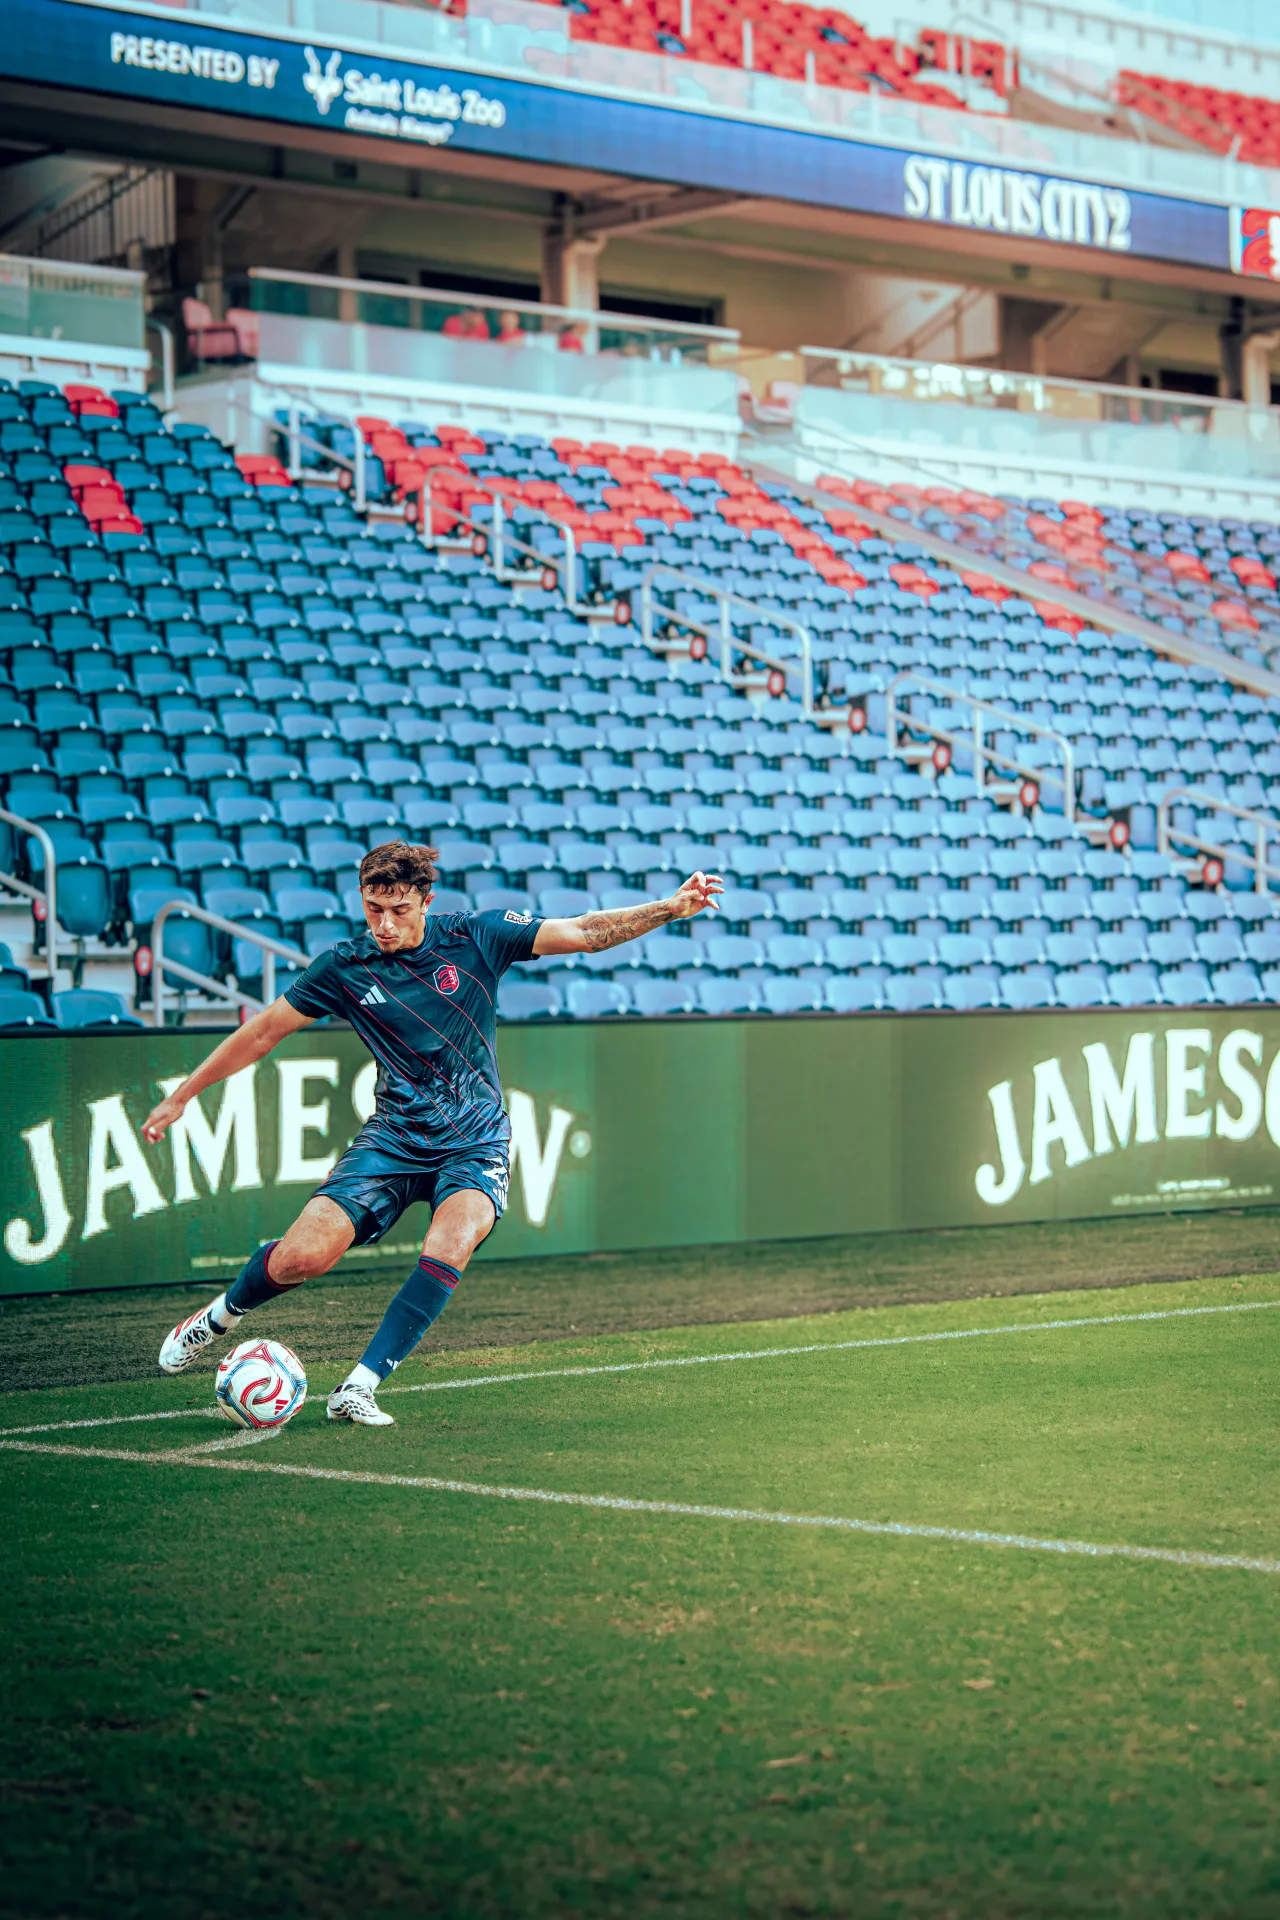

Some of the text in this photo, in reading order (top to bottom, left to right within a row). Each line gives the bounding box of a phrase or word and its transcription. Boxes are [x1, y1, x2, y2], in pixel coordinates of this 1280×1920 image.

[111, 32, 280, 89] PRESENTED BY
[344, 69, 402, 111] Saint
[403, 79, 461, 121] Louis
[462, 89, 506, 128] Zoo
[903, 154, 950, 220] ST
[950, 162, 1042, 236] LOUIS
[975, 1028, 1280, 1206] JAMES
[4, 1057, 575, 1266] JAMEN
